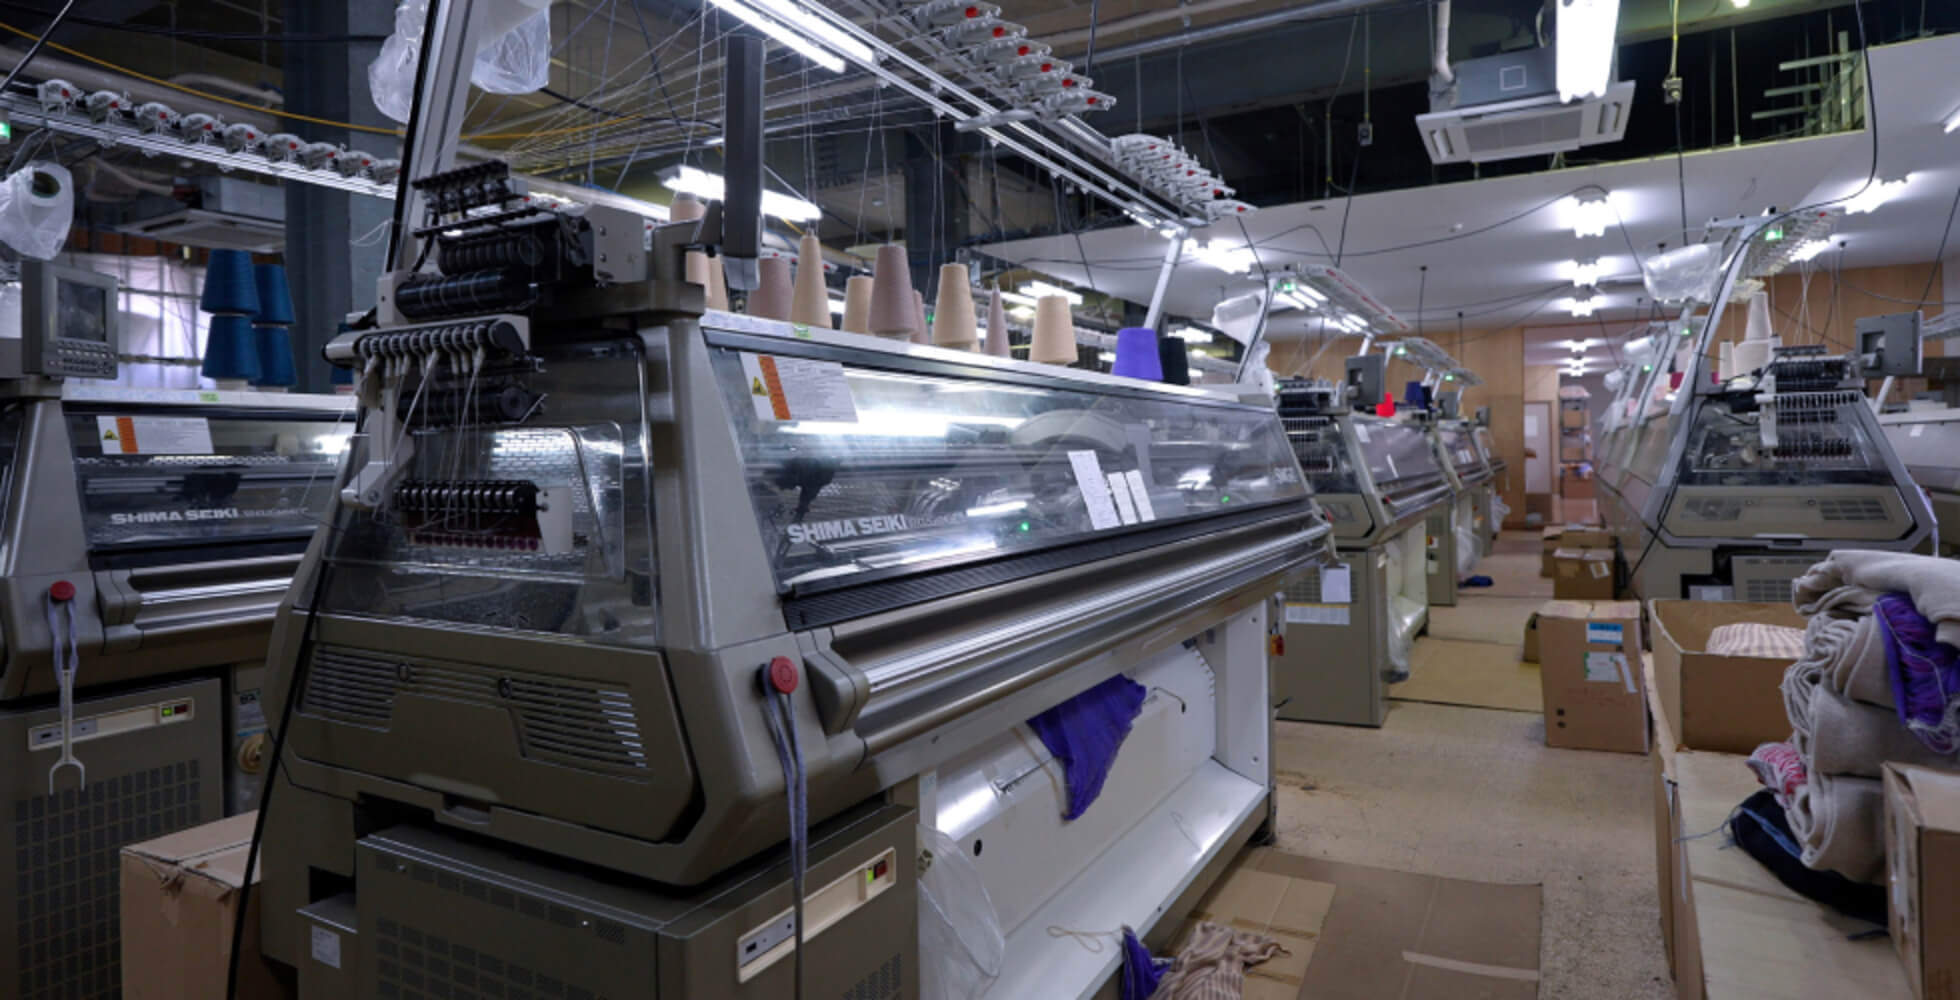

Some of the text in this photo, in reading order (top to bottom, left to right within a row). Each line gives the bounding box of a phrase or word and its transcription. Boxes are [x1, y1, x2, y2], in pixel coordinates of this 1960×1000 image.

[110, 511, 183, 525] SHIMA
[184, 507, 239, 521] SEIKI
[787, 520, 857, 544] SHIMA
[859, 514, 907, 535] SEIKI
